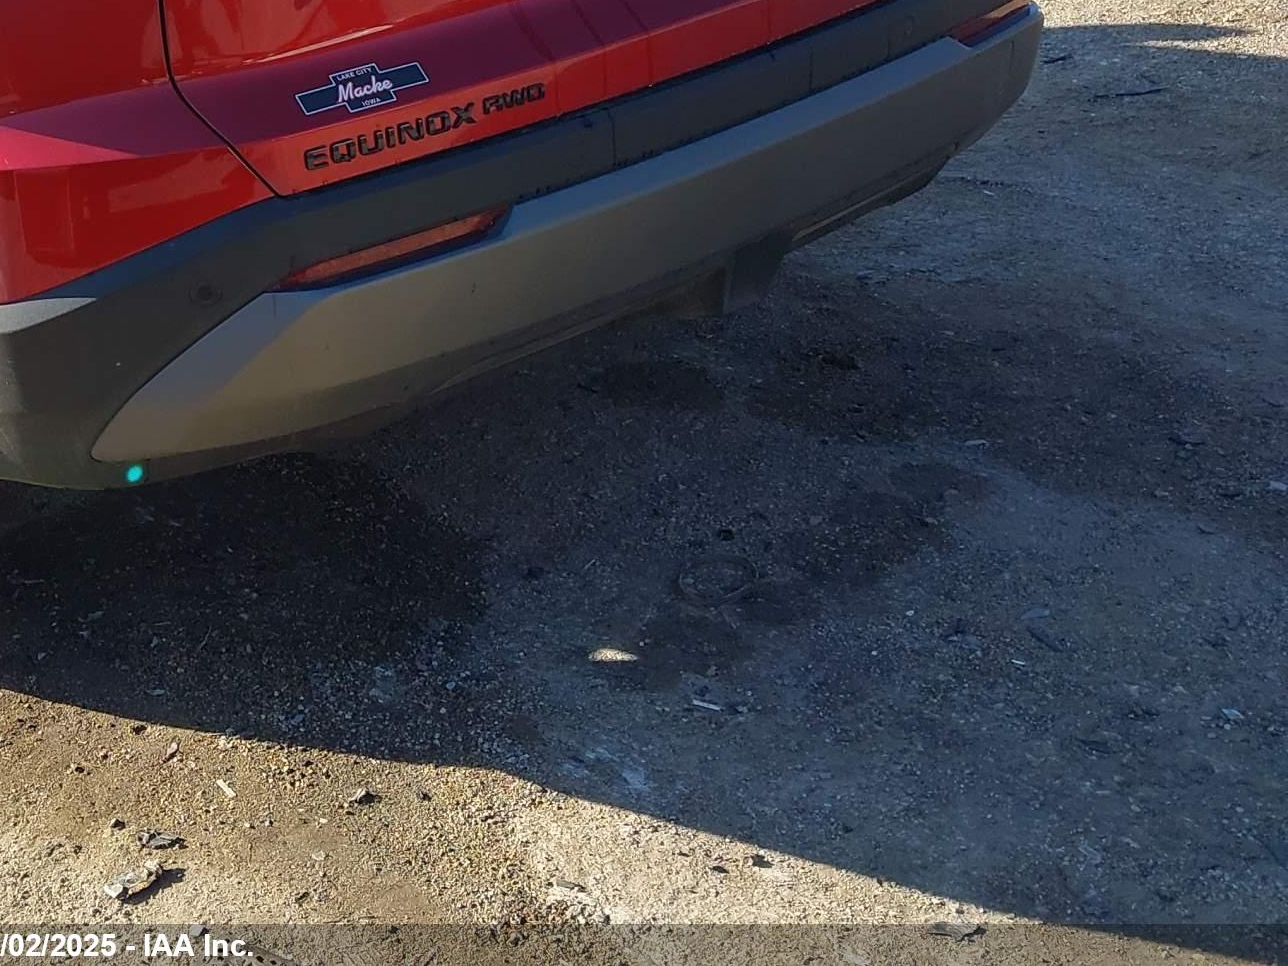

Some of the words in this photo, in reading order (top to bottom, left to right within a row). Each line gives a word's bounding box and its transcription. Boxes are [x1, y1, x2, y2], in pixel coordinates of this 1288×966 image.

[337, 72, 355, 81] LAKE
[356, 67, 372, 76] CITY
[338, 75, 393, 103] Macke
[362, 97, 382, 106] IOWA
[303, 102, 477, 171] EQUINOX
[483, 82, 545, 115] AWD
